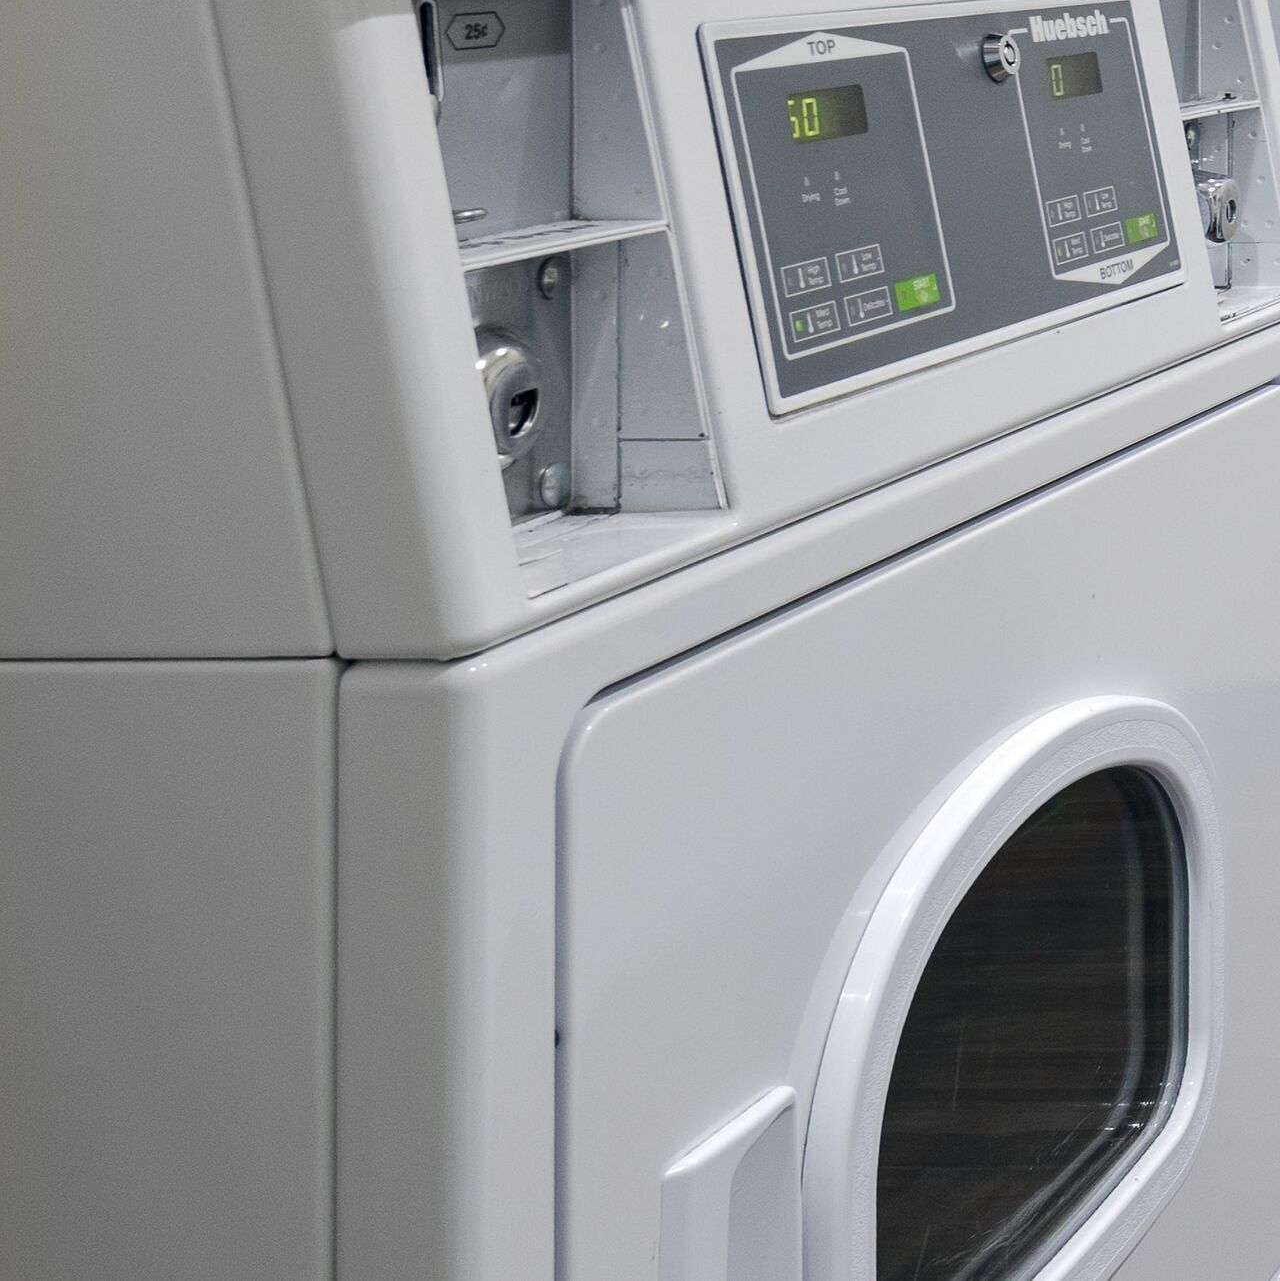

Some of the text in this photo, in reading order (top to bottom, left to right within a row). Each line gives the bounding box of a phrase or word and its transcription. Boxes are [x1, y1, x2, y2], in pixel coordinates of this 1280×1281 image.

[465, 23, 488, 40] 25¢
[1029, 9, 1109, 42] Huebsch
[807, 39, 836, 56] TOP
[1099, 258, 1134, 280] BOTTOM
